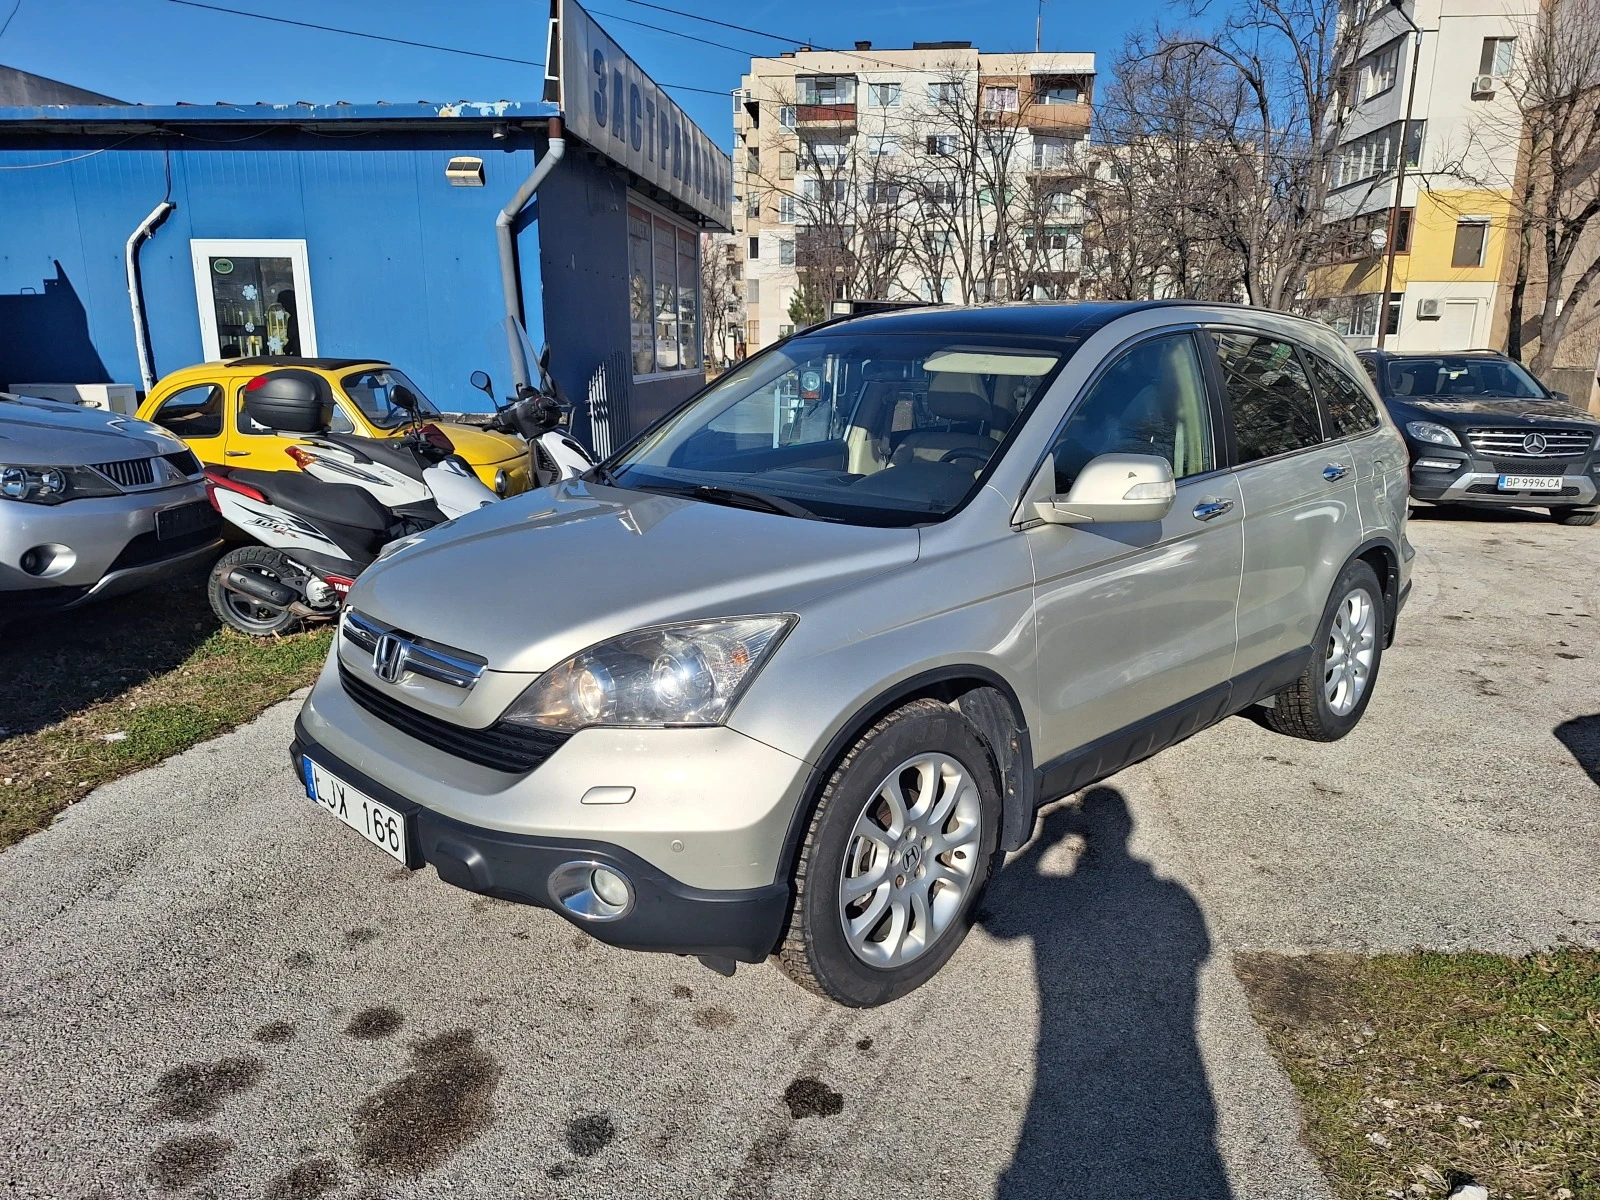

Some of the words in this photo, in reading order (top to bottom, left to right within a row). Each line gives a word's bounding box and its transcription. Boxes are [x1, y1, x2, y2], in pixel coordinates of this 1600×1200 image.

[593, 48, 726, 212] ЗАСТРАХОВКИ
[1506, 477, 1520, 487] BP
[1522, 478, 1546, 488] 9996
[1547, 478, 1560, 488] CA
[334, 582, 351, 593] YAM
[314, 768, 348, 819] LJX
[362, 801, 400, 853] 166
